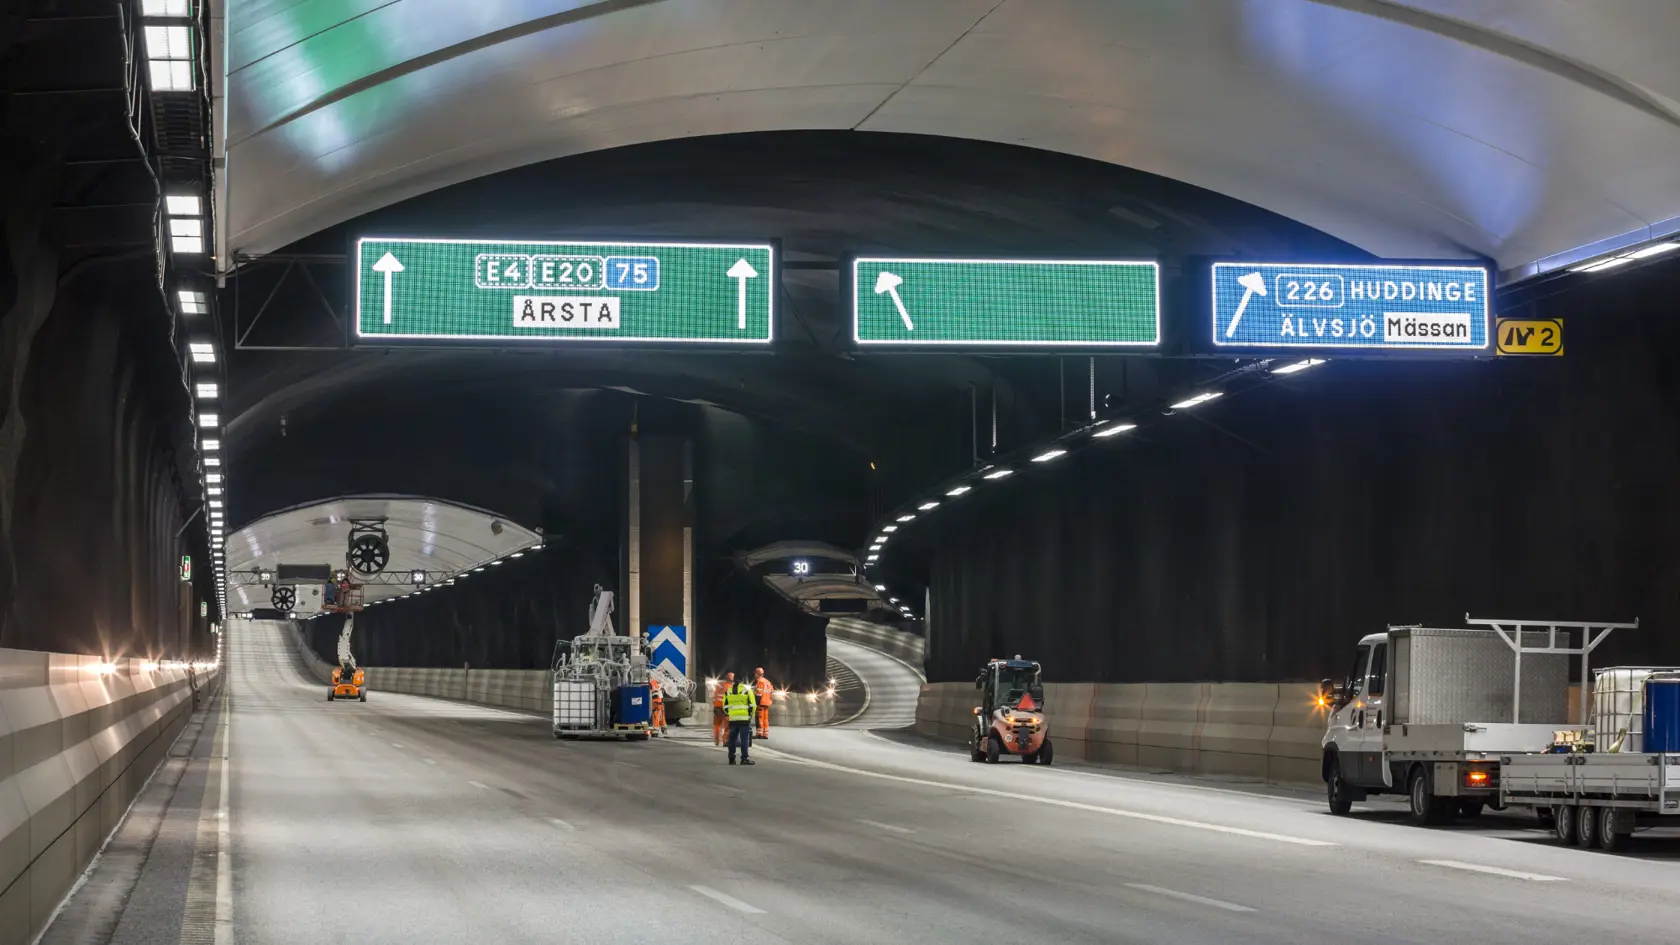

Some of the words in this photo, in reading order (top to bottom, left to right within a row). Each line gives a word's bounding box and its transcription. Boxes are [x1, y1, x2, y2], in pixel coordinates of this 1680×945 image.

[488, 261, 520, 281] E4
[541, 261, 592, 282] E20
[616, 262, 648, 283] 75
[1286, 281, 1333, 301] 226
[1350, 281, 1476, 302] HUDDINGE
[521, 299, 613, 322] ÅRSTA
[1280, 313, 1376, 338] ÄLVSJÖ
[1388, 316, 1468, 338] Mässan
[1541, 327, 1555, 345] 2
[414, 573, 424, 581] 30
[794, 562, 808, 573] 30
